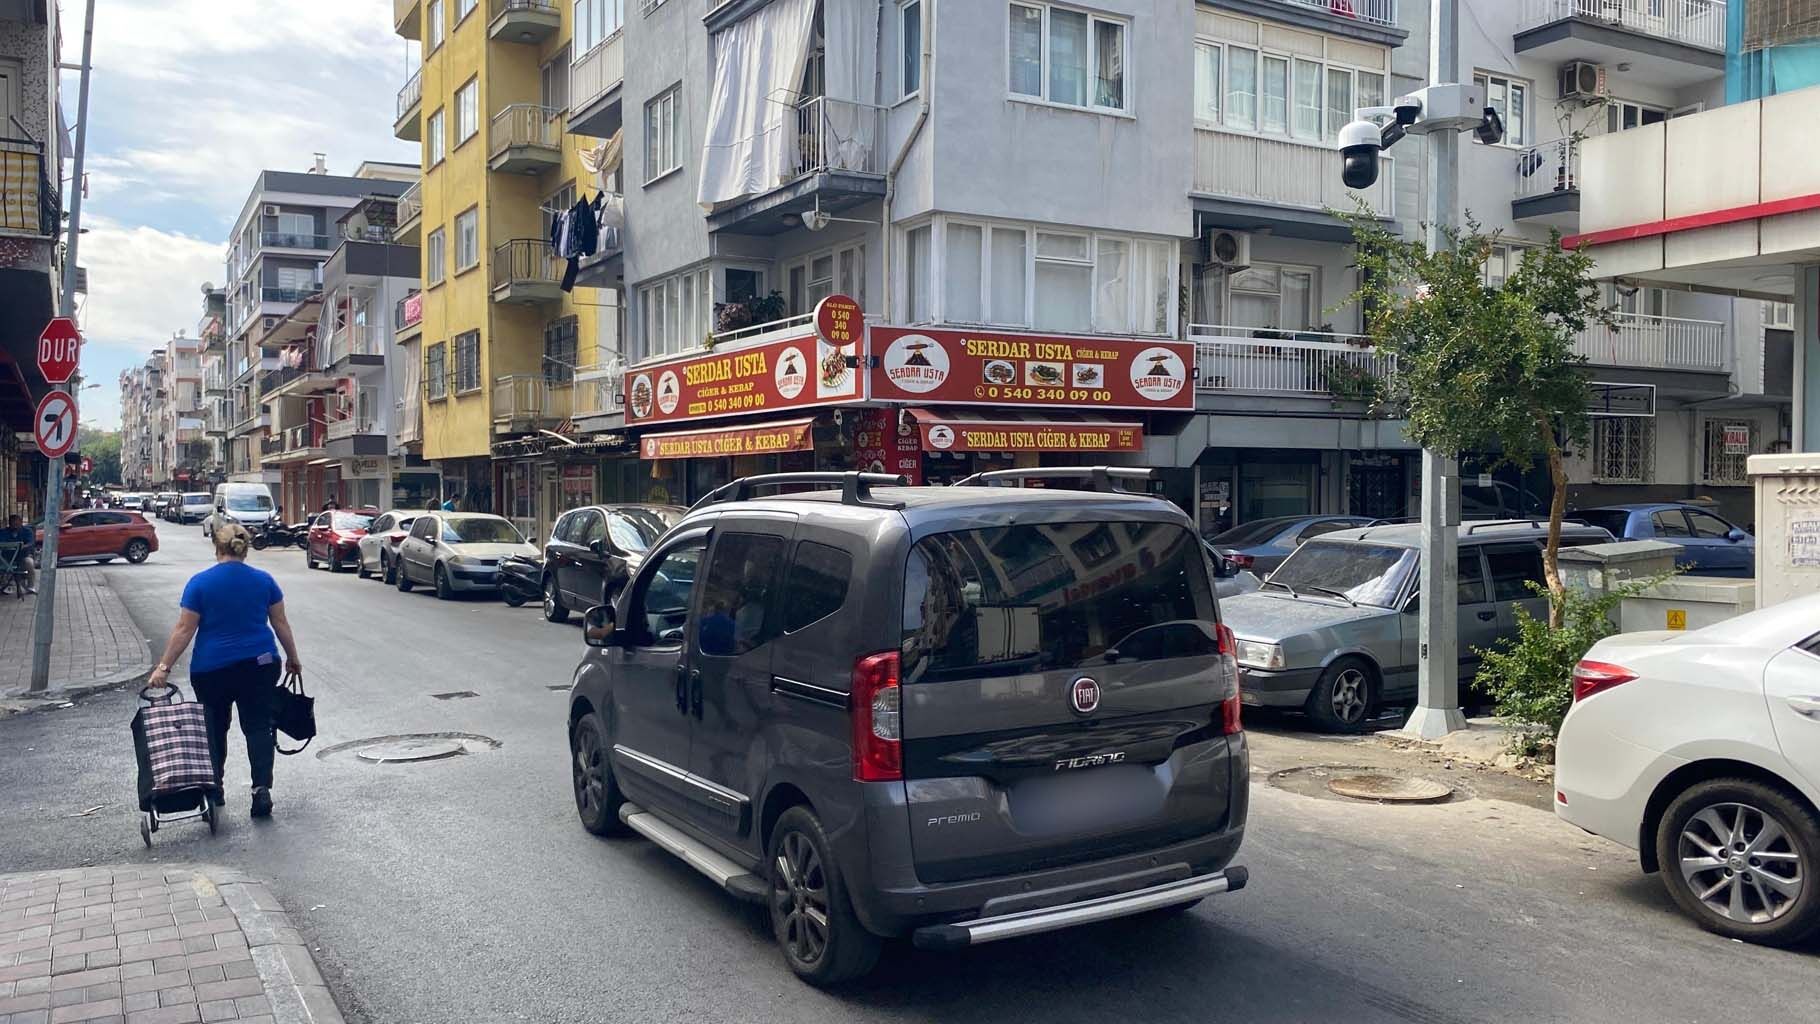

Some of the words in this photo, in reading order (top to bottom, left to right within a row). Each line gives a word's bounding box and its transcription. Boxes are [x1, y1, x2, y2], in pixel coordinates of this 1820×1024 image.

[832, 310, 836, 319] 0
[838, 310, 850, 320] 540
[834, 320, 847, 330] 340
[832, 330, 840, 340] 09
[841, 331, 850, 340] 00
[41, 338, 77, 363] DUR
[966, 339, 1032, 358] SERDAR
[1035, 343, 1074, 360] USTA
[1094, 350, 1100, 359] &
[1100, 350, 1119, 360] KEBAP
[686, 358, 732, 386] SERDAR
[735, 352, 768, 378] USTA
[890, 366, 921, 380] SERDAR
[924, 368, 945, 382] USTA
[721, 386, 727, 395] &
[728, 382, 754, 394] KEBAP
[1135, 376, 1161, 389] SERDAR
[1164, 378, 1182, 390] USTA
[988, 386, 998, 398] 0
[1004, 388, 1032, 399] 540
[1037, 388, 1065, 400] 340
[1070, 390, 1088, 401] 09
[1093, 391, 1111, 402] 00
[708, 400, 713, 412] 0
[714, 398, 727, 412] 540
[728, 396, 742, 410] 340
[744, 394, 753, 408] 09
[755, 393, 765, 406] 00
[660, 440, 690, 456] SERDAR
[692, 440, 712, 454] USTA
[745, 436, 753, 450] &
[756, 433, 790, 450] KEBAP
[967, 432, 1008, 448] SERDAR
[1010, 432, 1036, 448] USTA
[1037, 428, 1068, 448] CİĞER
[1070, 432, 1077, 448] &
[1079, 433, 1110, 448] KEBAP
[1078, 688, 1094, 704] FIAT
[1056, 752, 1126, 770] FIORINO
